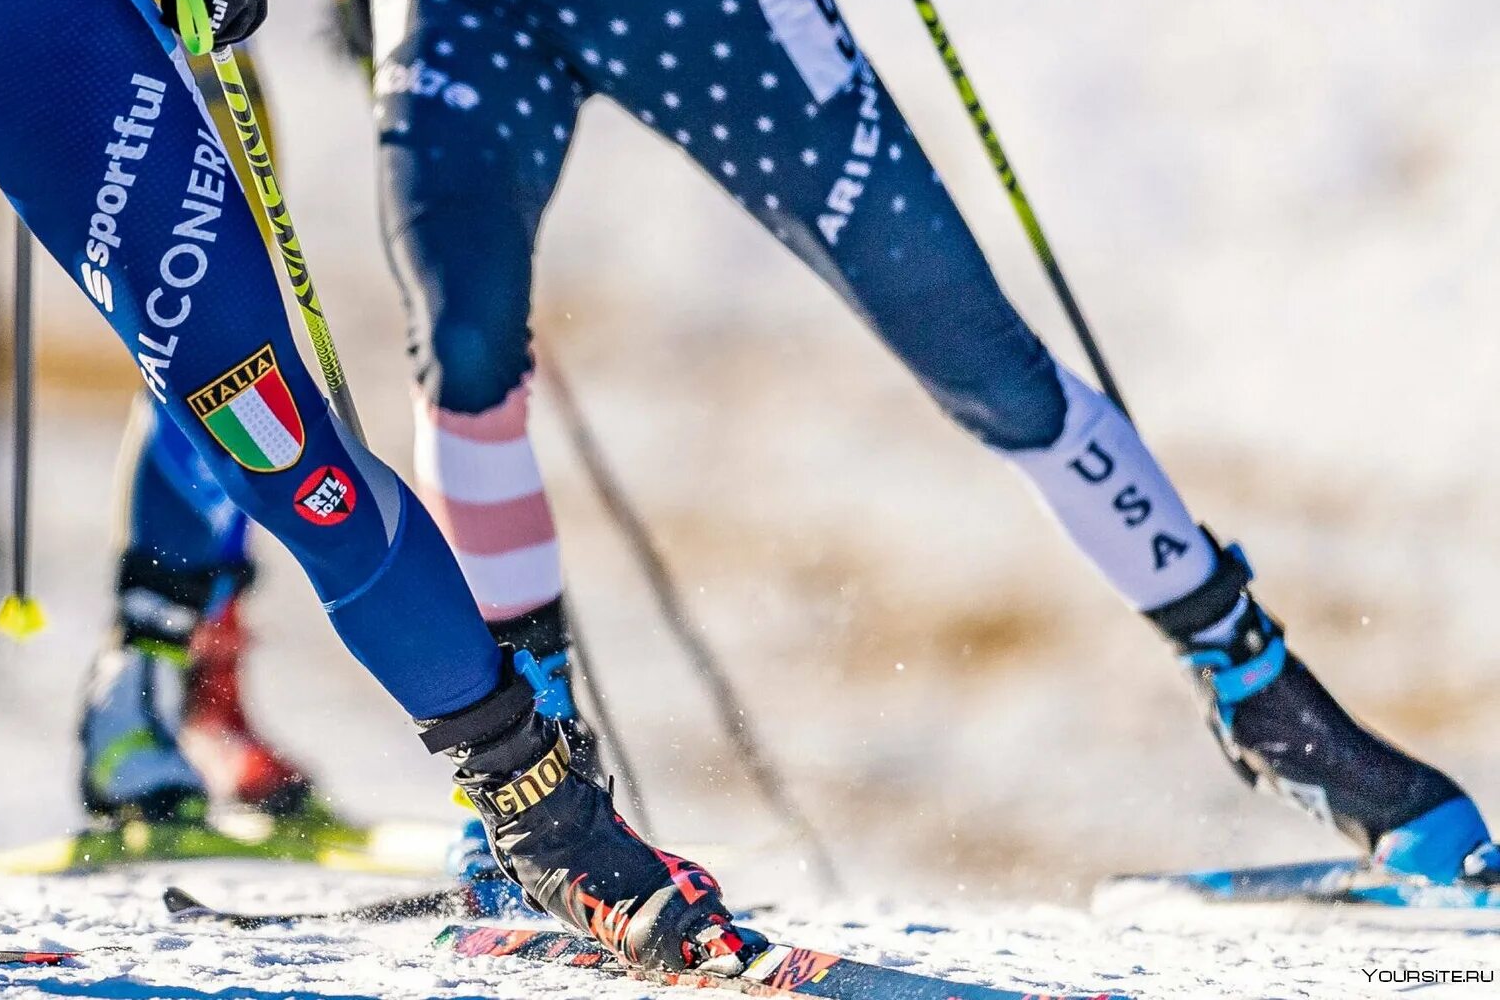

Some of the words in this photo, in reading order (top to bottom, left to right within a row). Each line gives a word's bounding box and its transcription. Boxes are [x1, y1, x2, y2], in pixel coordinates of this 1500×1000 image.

[85, 72, 168, 268] sportful
[195, 356, 274, 414] ITALIA
[303, 476, 341, 512] RTL
[316, 483, 348, 518] 102.5
[1067, 441, 1189, 571] USA
